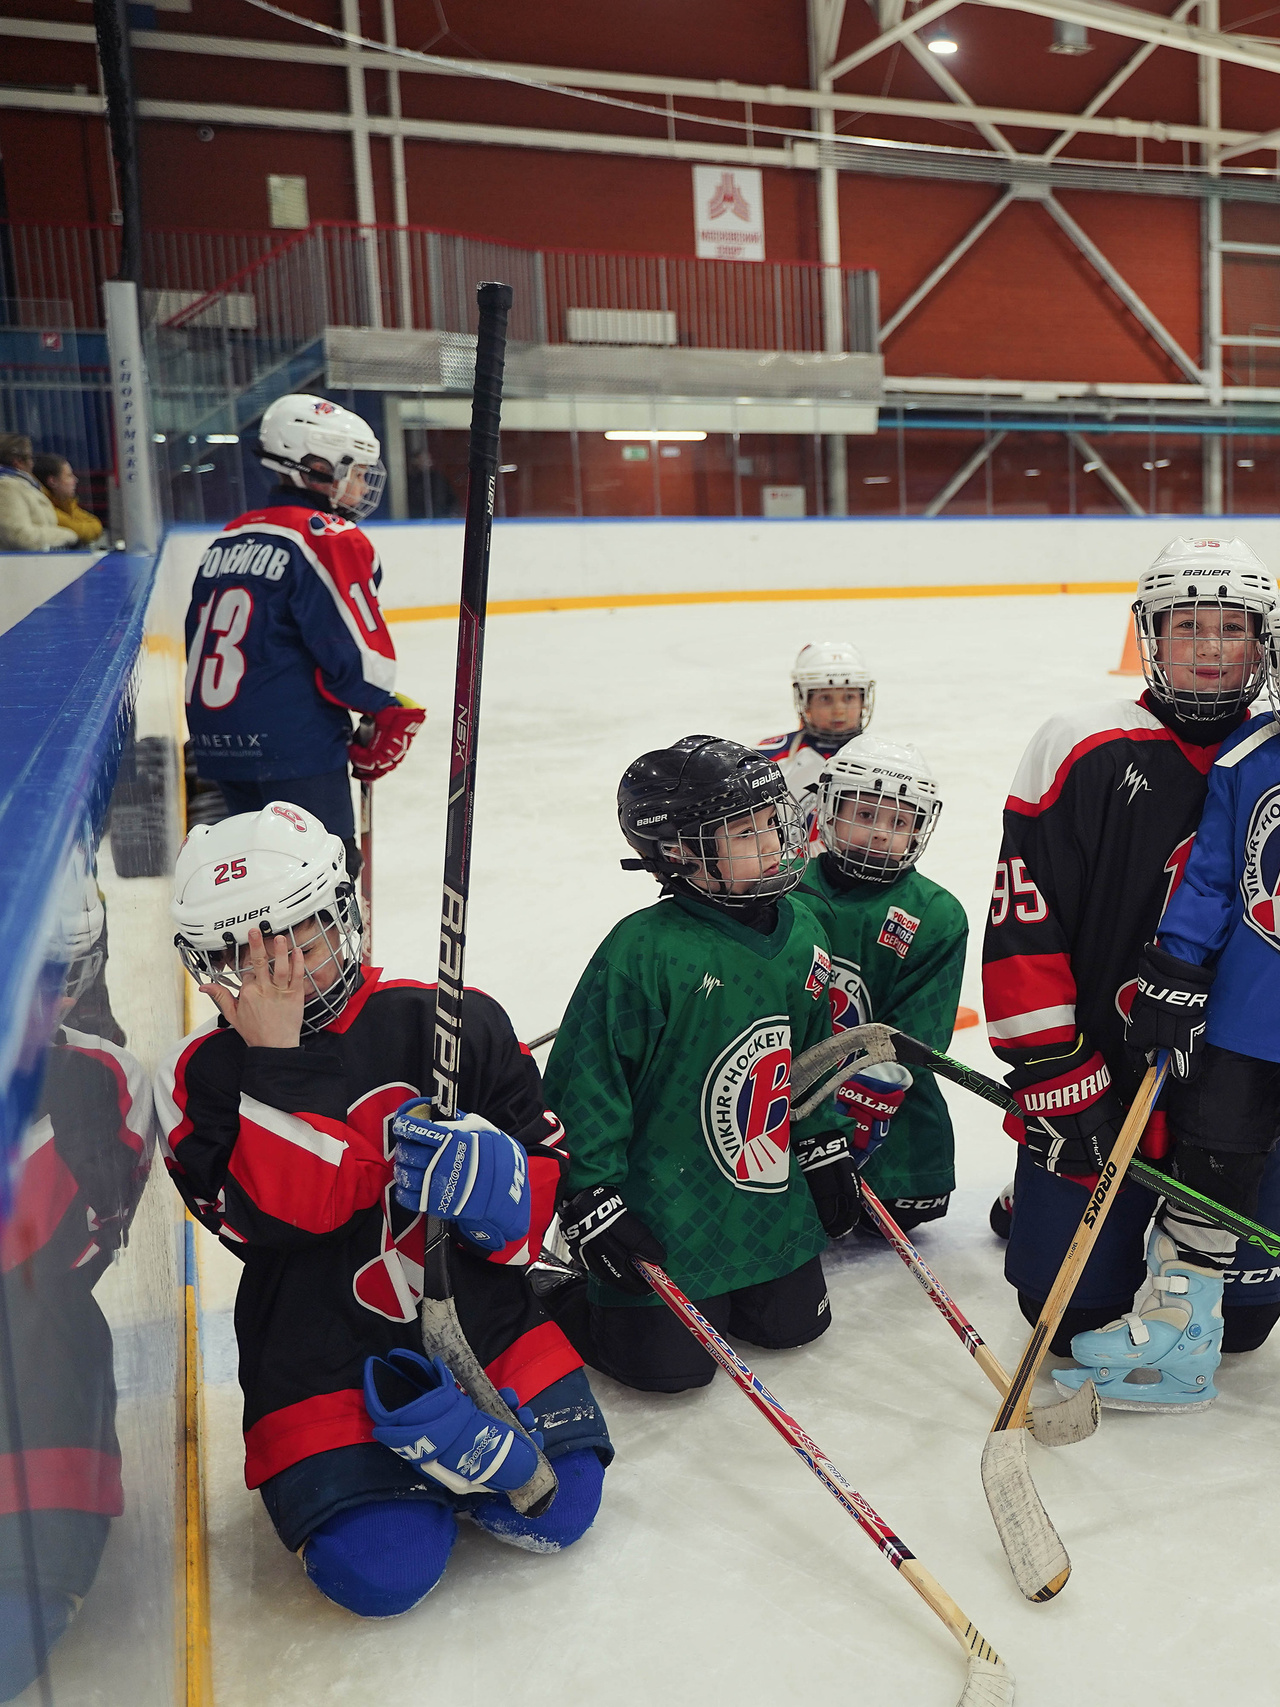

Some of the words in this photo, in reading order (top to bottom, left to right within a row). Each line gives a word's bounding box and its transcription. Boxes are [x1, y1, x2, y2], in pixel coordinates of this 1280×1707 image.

[1182, 568, 1231, 577] BAUER
[186, 586, 254, 711] 13
[453, 703, 468, 762] NSX
[751, 770, 782, 789] BAUER
[872, 767, 913, 782] BAUER
[636, 813, 668, 827] BAUER
[214, 858, 247, 885] 25
[1246, 838, 1260, 899] VIKHR
[991, 856, 1051, 926] 95
[213, 905, 270, 931] BAUER
[432, 884, 464, 1118] BAUER
[724, 1031, 785, 1085] HOCKEY
[716, 1095, 741, 1159] VIKHR
[1092, 1135, 1103, 1167] ALPHA
[592, 1187, 605, 1197] RS
[895, 1194, 949, 1210] CCM
[1083, 1161, 1118, 1230] OROKS
[601, 1254, 622, 1278] STEALTH
[795, 1447, 860, 1521] Atom
